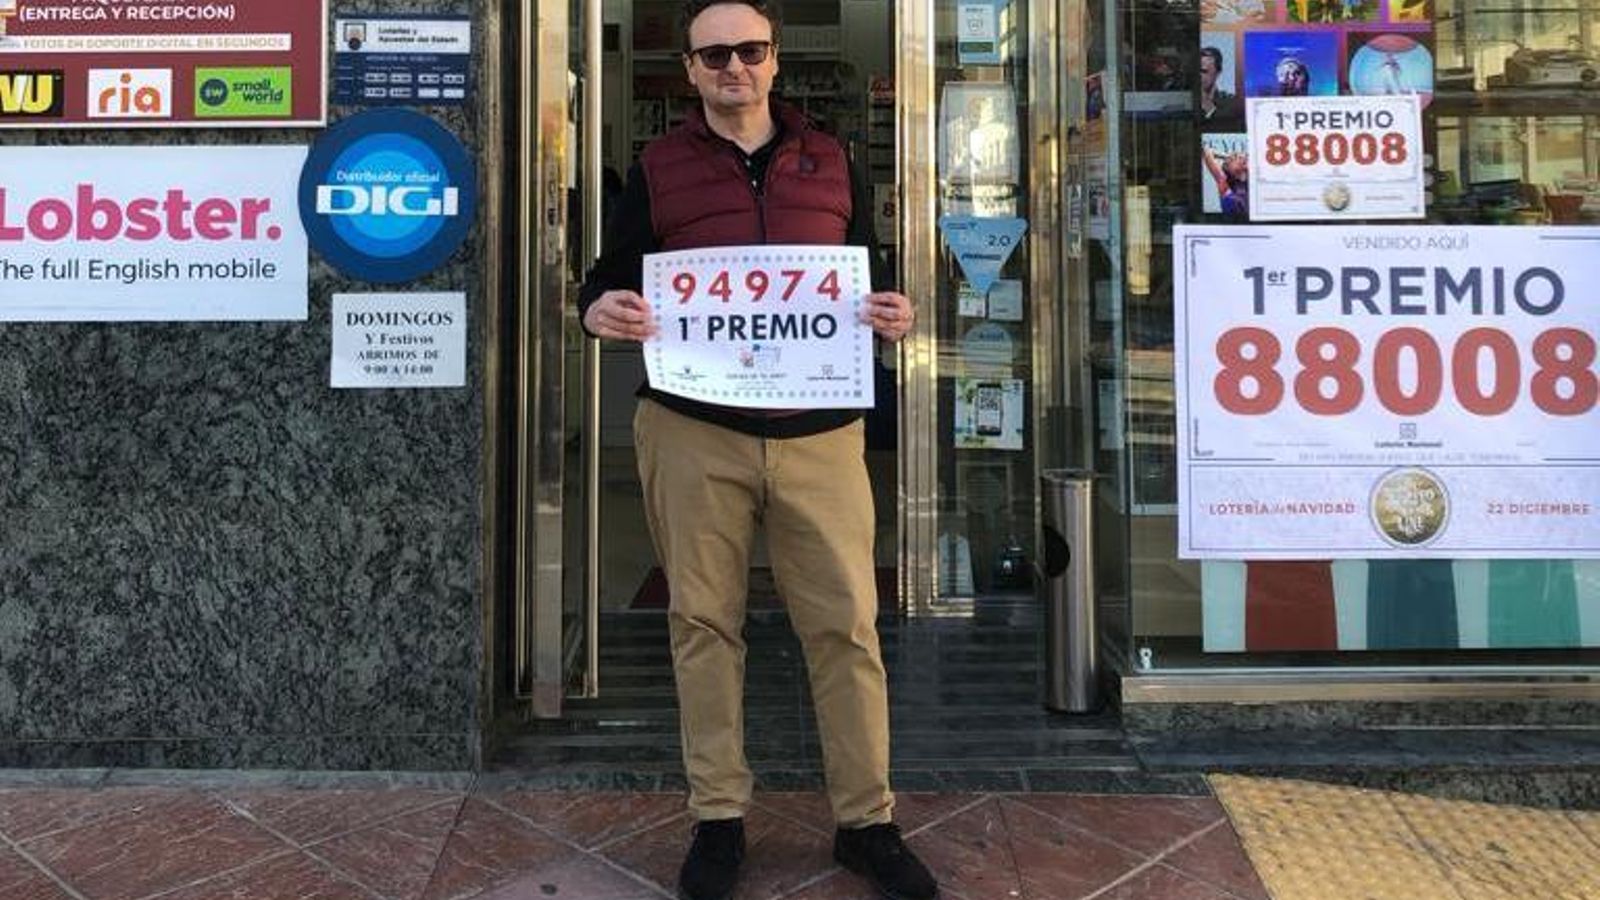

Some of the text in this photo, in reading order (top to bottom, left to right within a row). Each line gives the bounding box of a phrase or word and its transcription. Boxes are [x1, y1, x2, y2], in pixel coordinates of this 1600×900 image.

[20, 3, 235, 22] (ENTREGA Y RECEPCIÓN)
[23, 38, 65, 49] FOTOS
[67, 38, 84, 48] EN
[99, 72, 161, 112] ria
[232, 78, 271, 92] small
[243, 88, 284, 102] world
[1294, 110, 1394, 129] PREMIO
[1265, 132, 1408, 166] 88008
[336, 170, 402, 182] Distribuidor
[316, 185, 459, 215] DIGI
[0, 184, 282, 241] Lobster.
[1343, 231, 1470, 251] VENDIDO AQUÍ
[0, 258, 277, 283] he full English mobile
[671, 268, 842, 304] 94974
[1243, 266, 1566, 316] 1er PREMIO
[346, 311, 453, 326] DOMINGOS
[707, 313, 838, 341] PREMIO
[365, 333, 434, 345] Y Festivos
[1213, 326, 1600, 416] 88008
[1209, 500, 1270, 516] LOTERÍA
[1286, 502, 1356, 515] NAVIDAD
[1487, 502, 1592, 515] 22 DICIEMBRE
